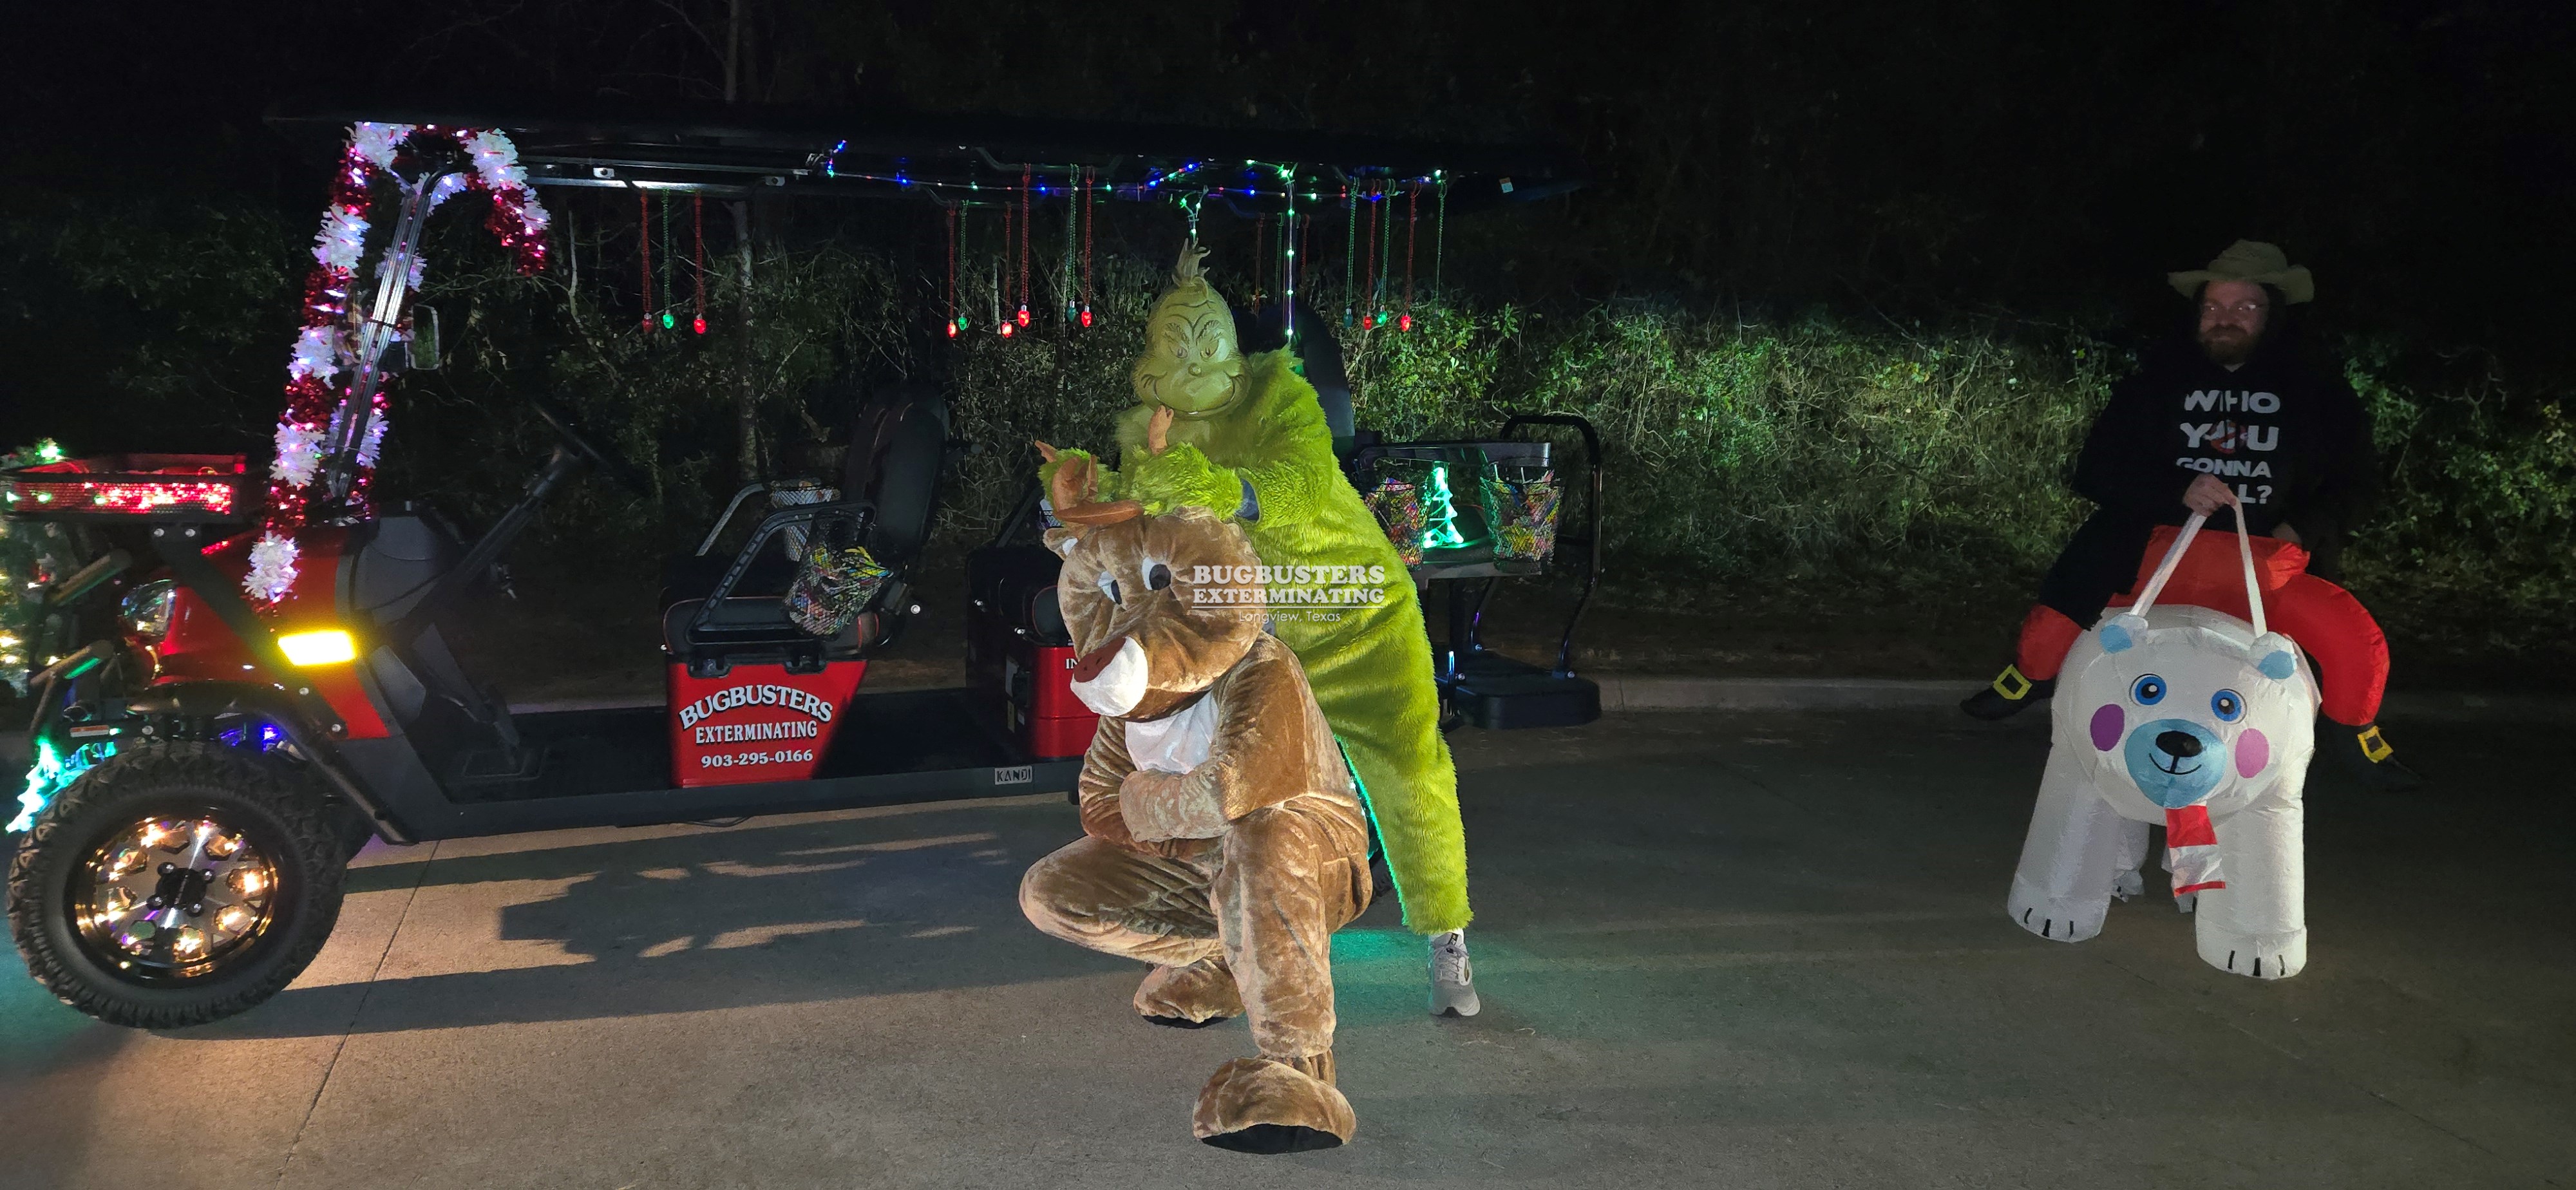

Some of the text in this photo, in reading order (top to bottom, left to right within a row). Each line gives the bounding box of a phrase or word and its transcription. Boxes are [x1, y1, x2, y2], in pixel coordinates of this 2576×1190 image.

[2184, 390, 2281, 413] WHO
[679, 685, 833, 729] BUGBUSTERS
[696, 720, 817, 744] EXTERMINATING
[701, 749, 813, 768] 903-295-0166
[996, 768, 1031, 782] KANDI
